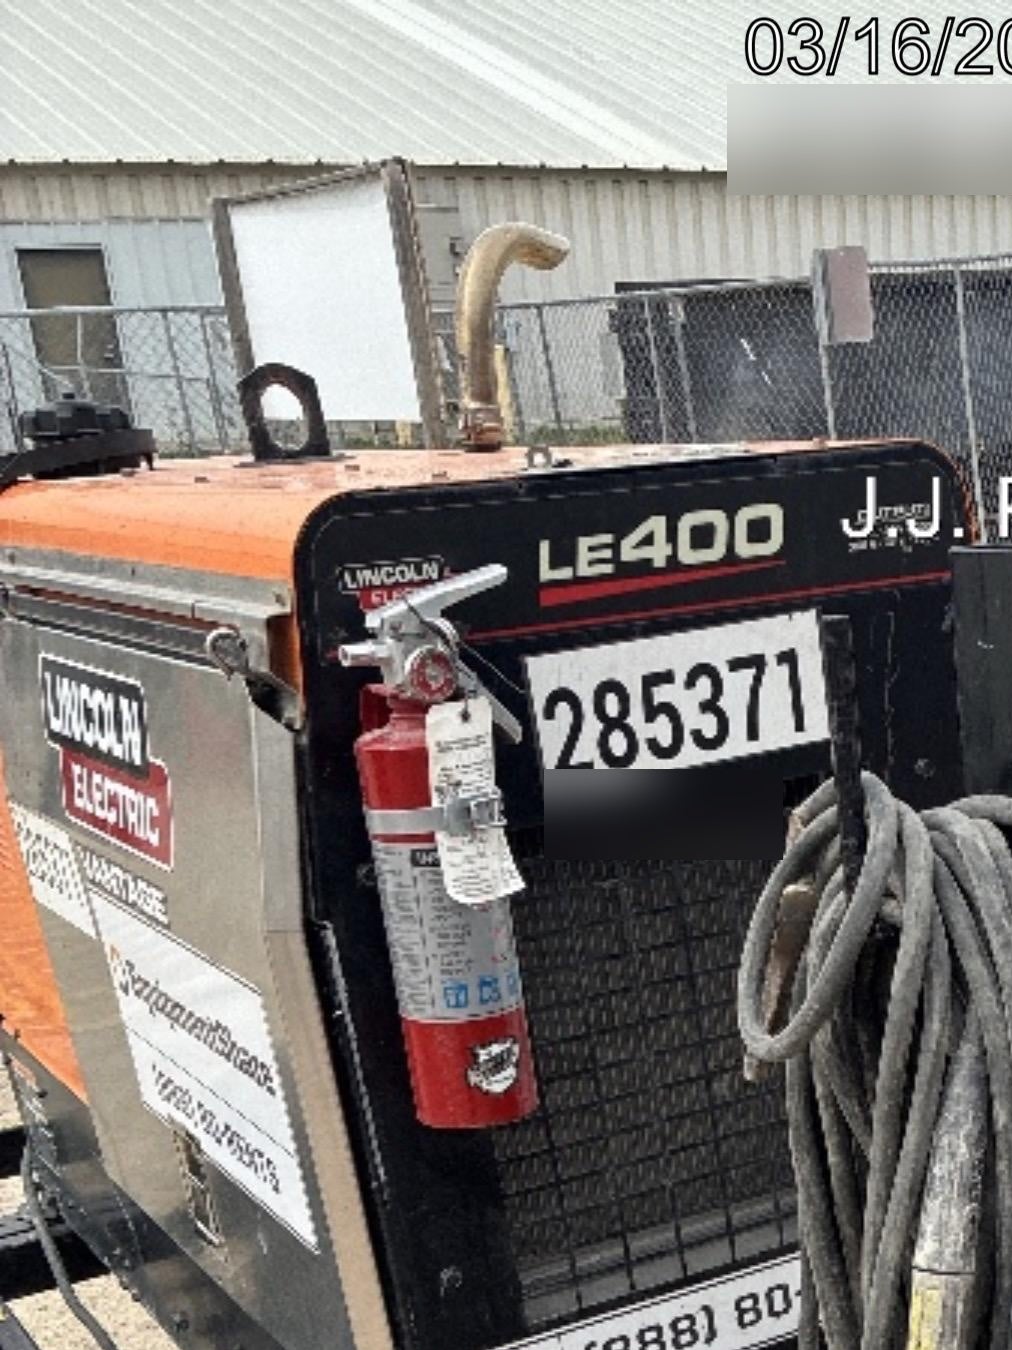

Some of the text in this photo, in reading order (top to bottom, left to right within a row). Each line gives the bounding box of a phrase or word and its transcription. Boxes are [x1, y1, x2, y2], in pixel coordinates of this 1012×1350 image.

[343, 561, 440, 589] LINCOLN
[538, 503, 785, 583] LE400
[44, 671, 142, 766] LINCOLN
[542, 648, 806, 769] 285371
[71, 763, 160, 847] ELECTRIC
